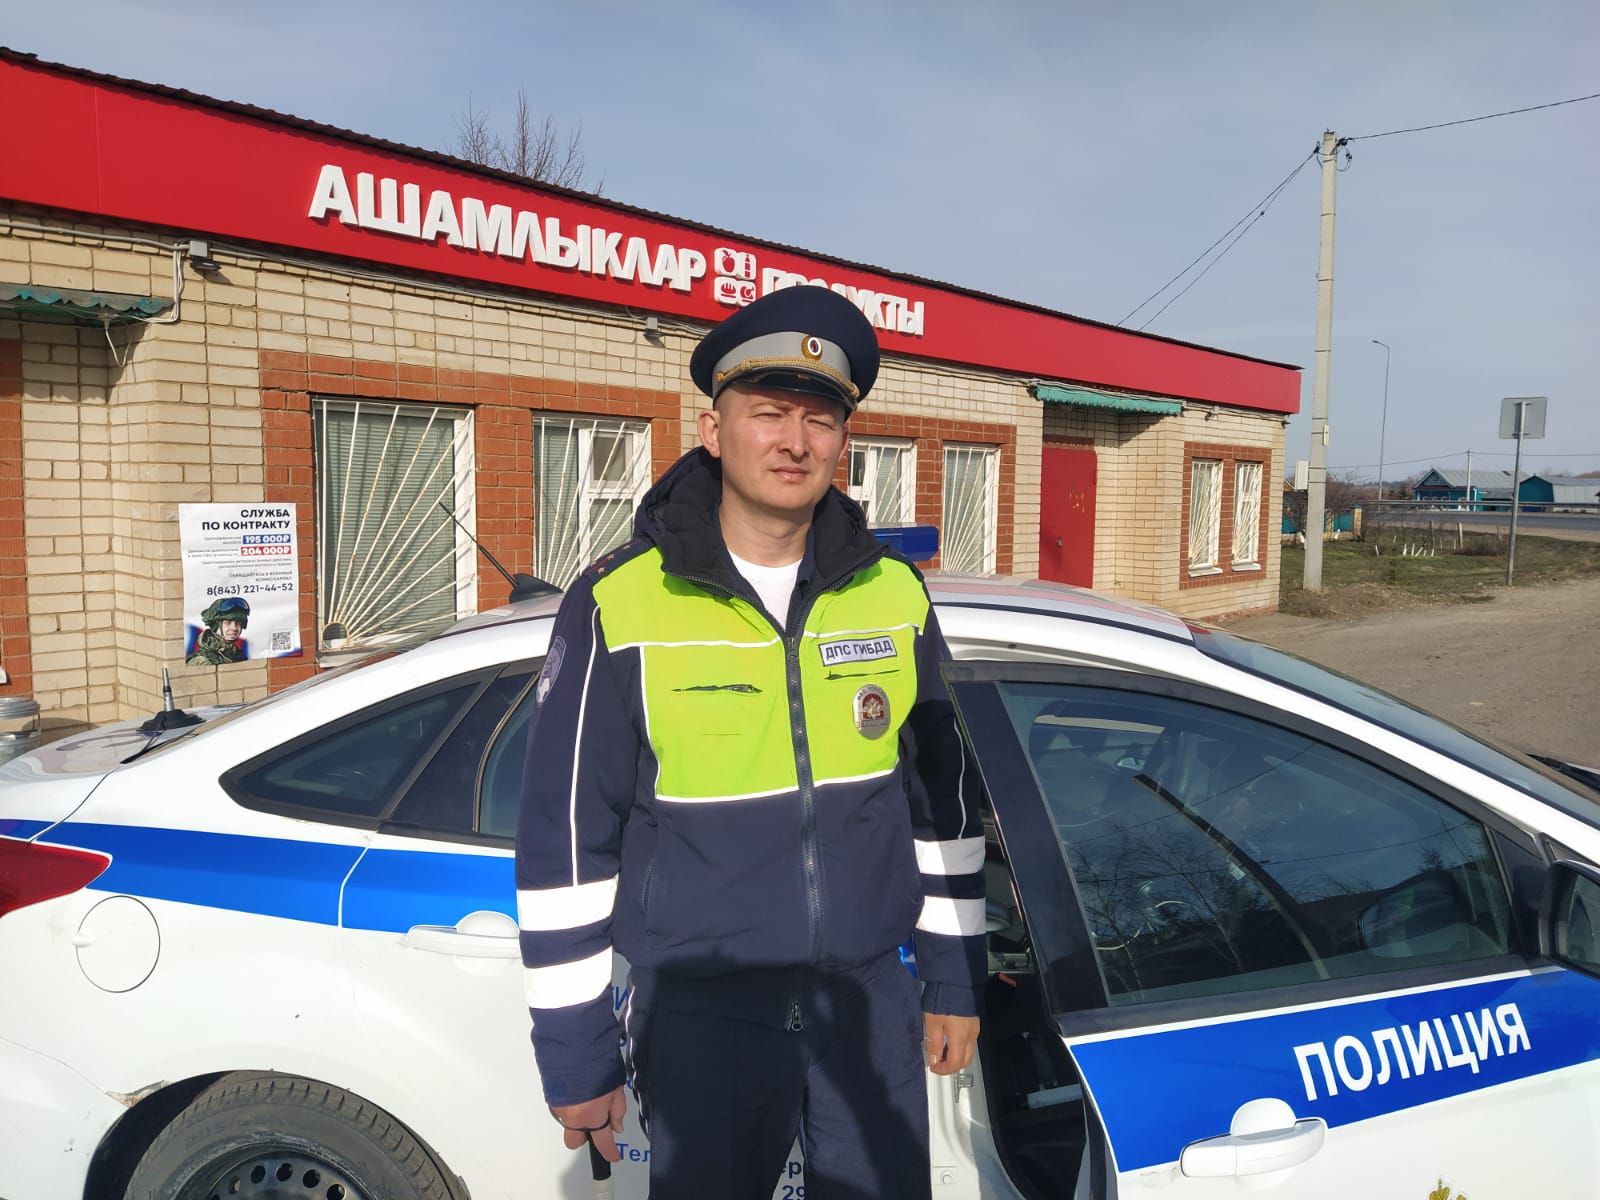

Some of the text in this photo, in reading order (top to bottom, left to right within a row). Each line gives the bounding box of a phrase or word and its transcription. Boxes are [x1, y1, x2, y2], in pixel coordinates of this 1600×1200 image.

[307, 164, 925, 335] АШАМЛЫКЛАР ПУКТЫ
[240, 509, 290, 518] СЛУЖБА
[202, 520, 290, 531] ПО КОНТРАКТУ
[245, 535, 261, 544] 195
[242, 547, 261, 556] 204
[206, 583, 294, 596] 8(843) 221-44-52
[825, 640, 894, 661] ДПС ГИБДД
[1293, 1002, 1532, 1101] ПОЛИЦИЯ
